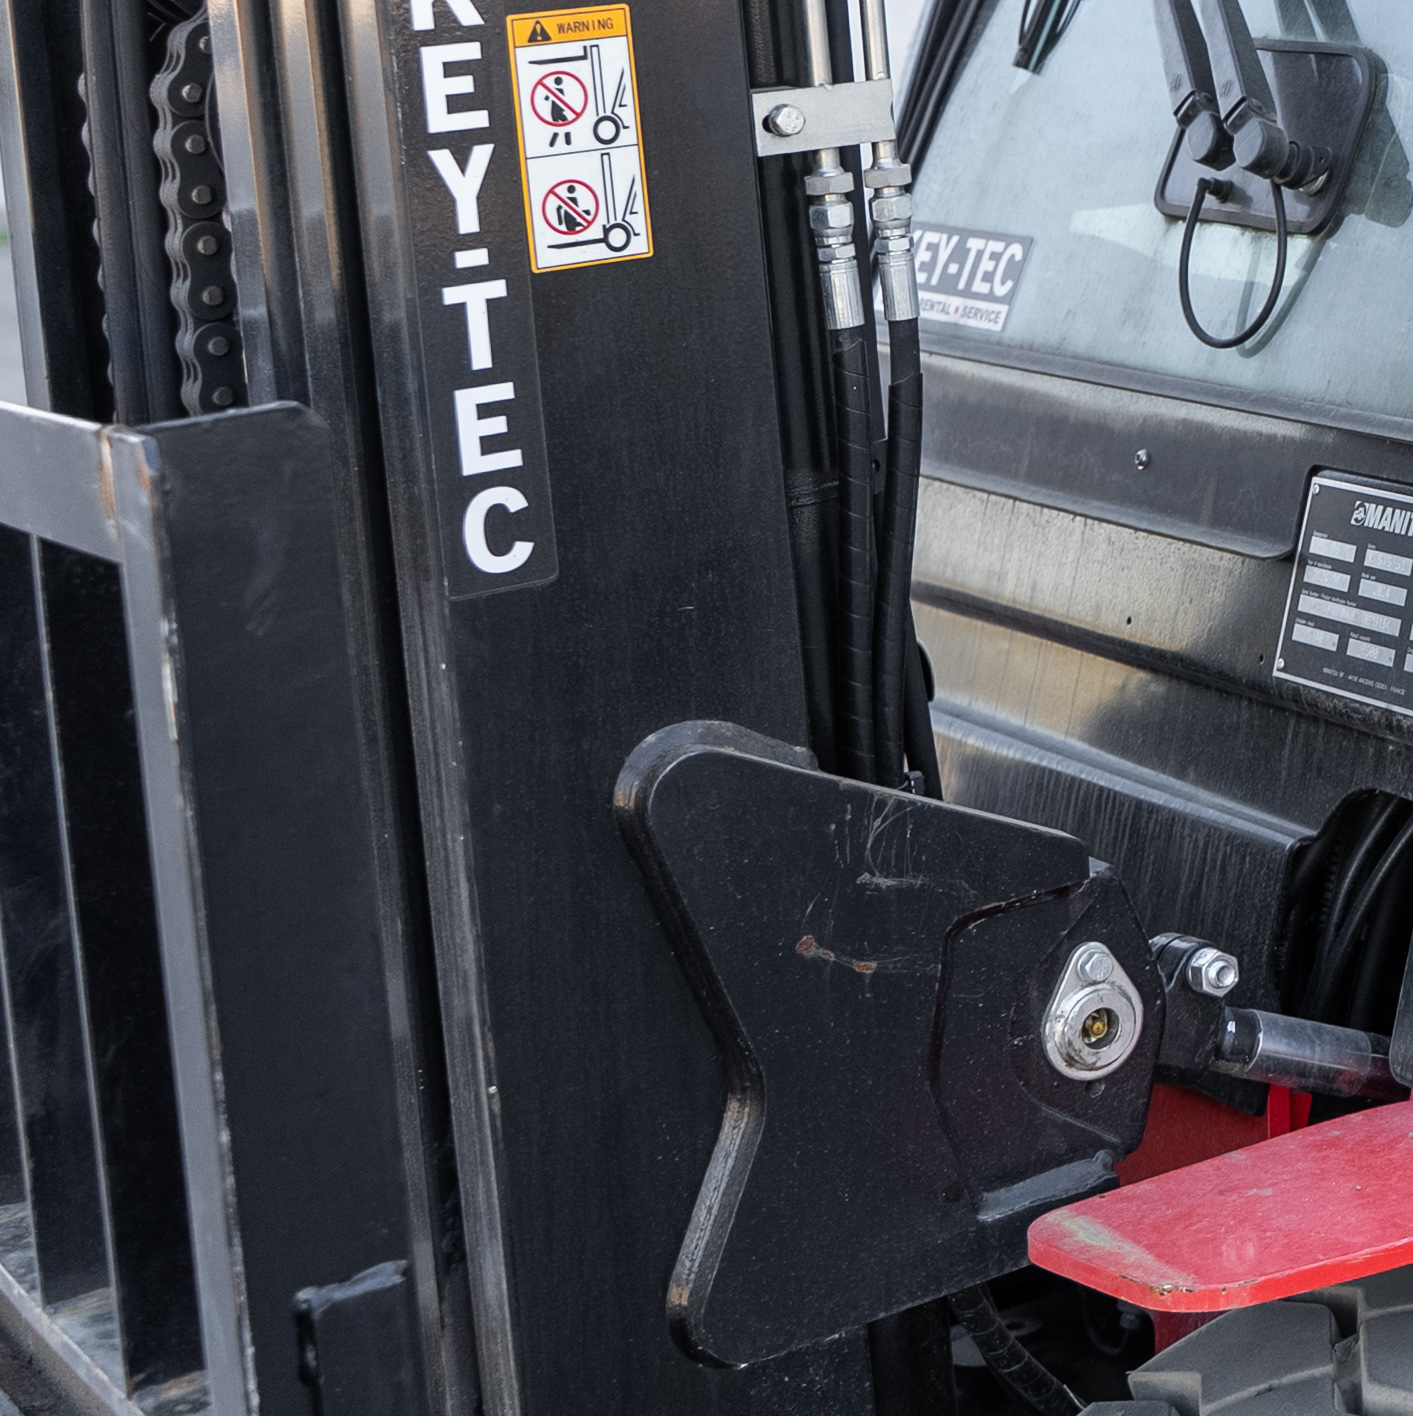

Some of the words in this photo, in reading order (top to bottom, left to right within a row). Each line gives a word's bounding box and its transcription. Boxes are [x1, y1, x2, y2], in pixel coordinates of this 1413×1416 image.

[556, 17, 614, 34] WARNING
[911, 229, 1024, 297] EY-TEC
[961, 305, 1002, 325] SERVICE
